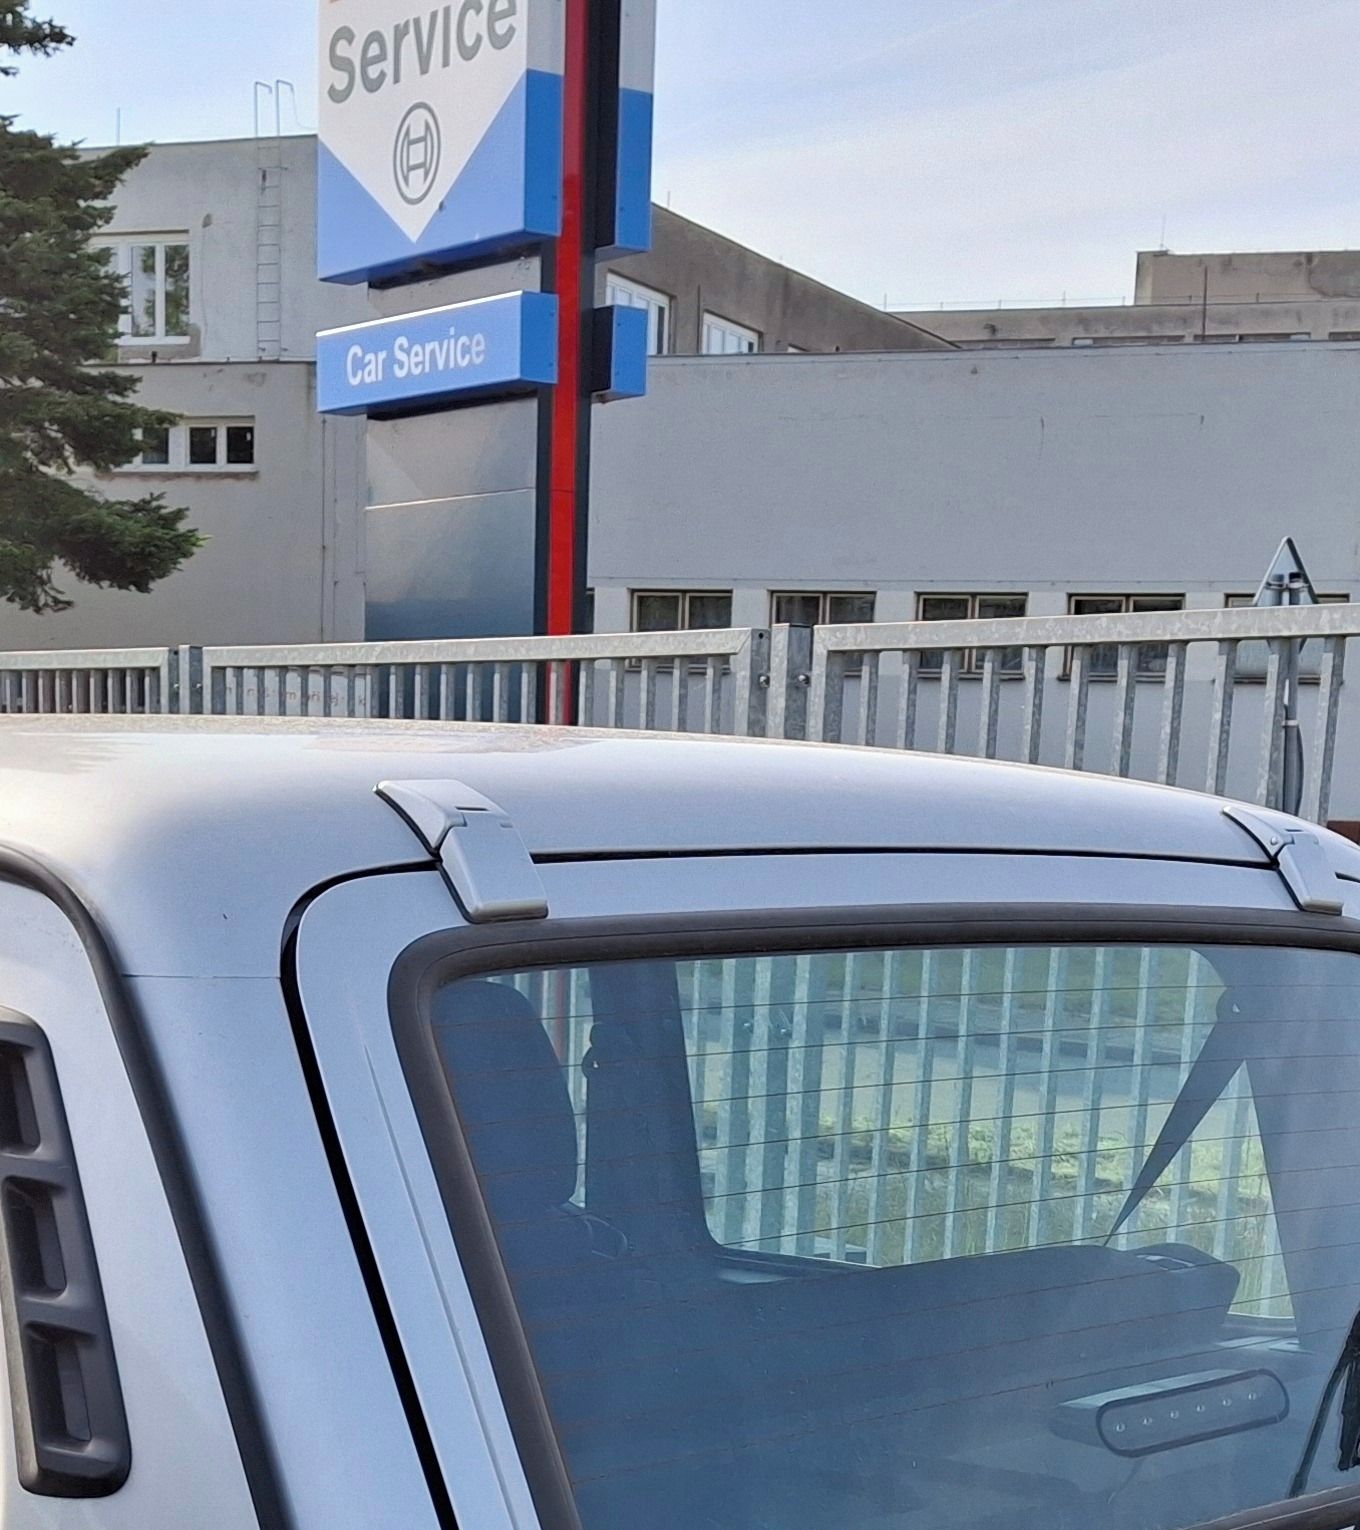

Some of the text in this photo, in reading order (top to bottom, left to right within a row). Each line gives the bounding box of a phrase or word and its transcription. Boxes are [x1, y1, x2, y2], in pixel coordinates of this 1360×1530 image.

[328, 0, 517, 104] Service
[347, 326, 485, 386] Car Service
